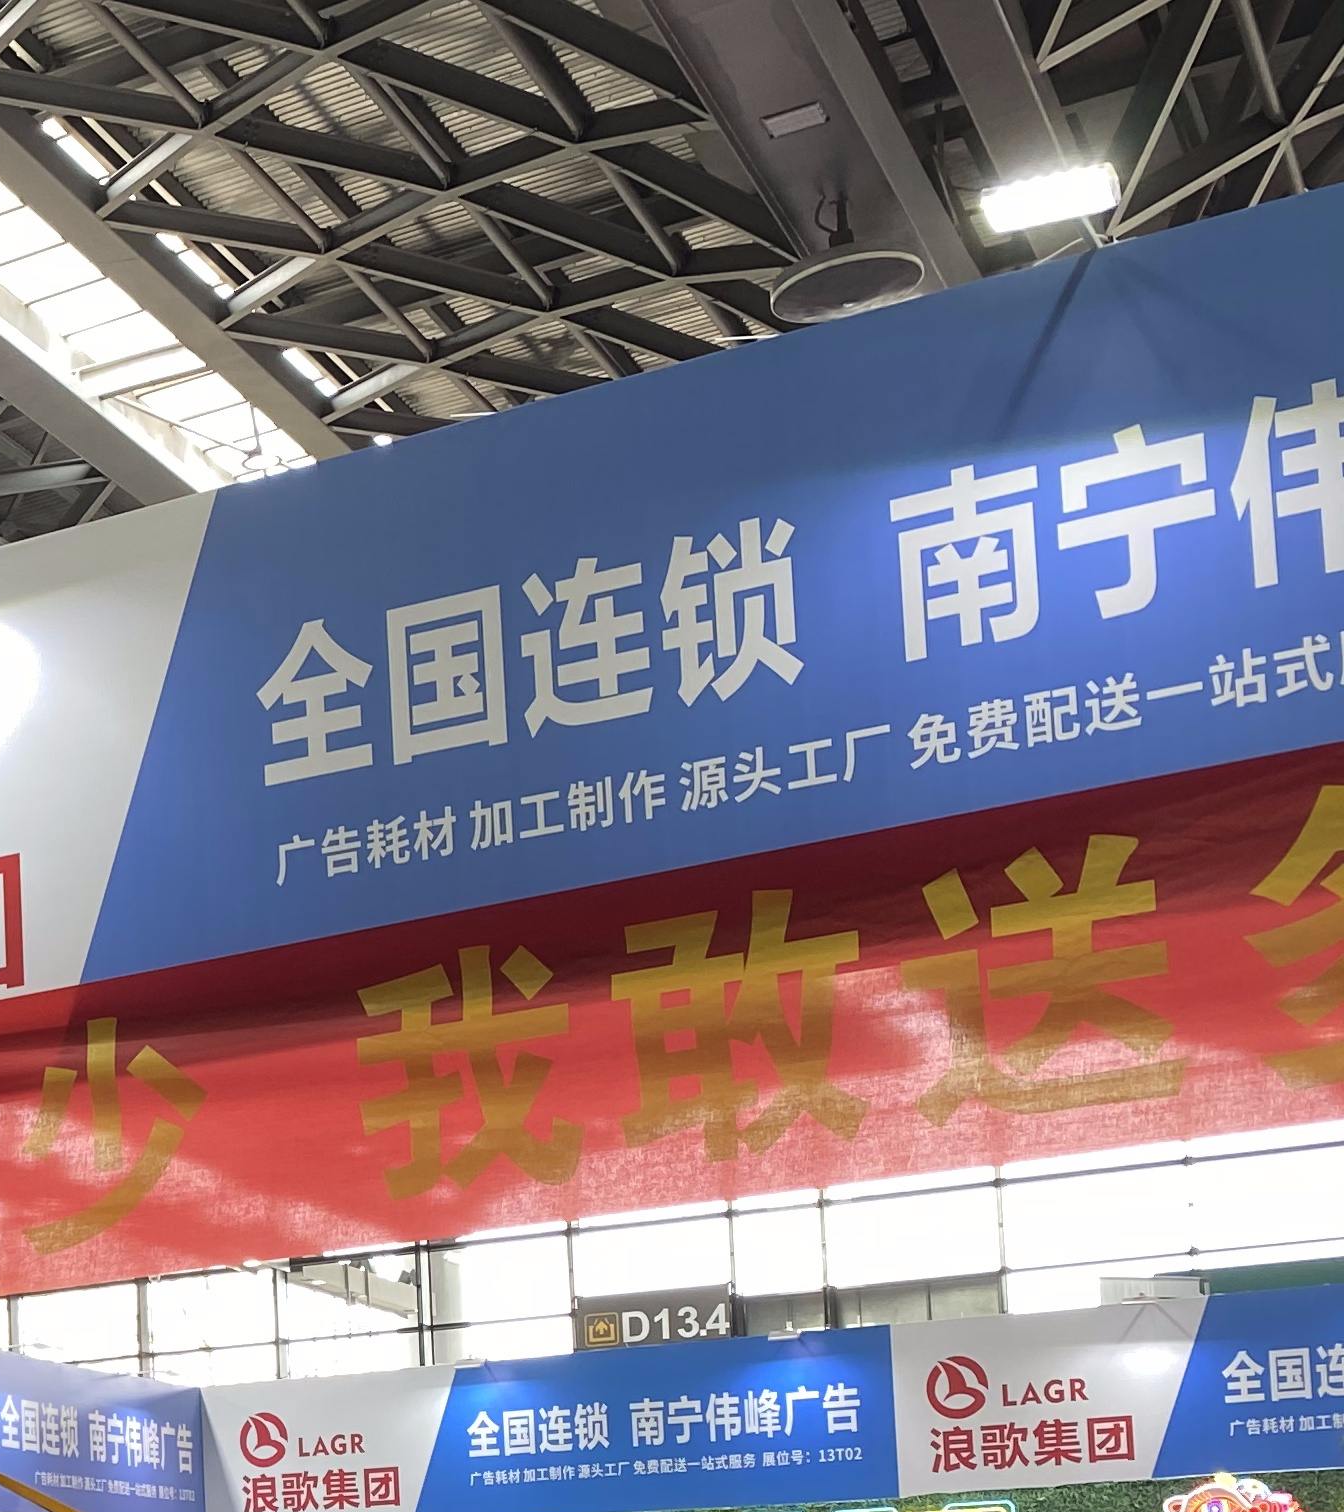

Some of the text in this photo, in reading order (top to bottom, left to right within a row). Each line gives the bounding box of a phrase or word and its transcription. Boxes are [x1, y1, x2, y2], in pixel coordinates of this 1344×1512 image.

[255, 517, 805, 787] 全国连锁
[275, 631, 1344, 886] 广告耗材 加工制作 源头工厂 免费配送一站式
[622, 1302, 731, 1344] D13.4
[1002, 1377, 1089, 1408] LAGR
[0, 1394, 194, 1475] 全国连锁 南宁伟峰广告
[298, 1433, 365, 1459] LAGR
[467, 1382, 862, 1459] 全国连锁 南宁伟峰广告
[930, 1414, 1136, 1474] 浪歌集团
[1229, 1414, 1295, 1437] 广告耗材
[469, 1468, 520, 1487] 广告耗材
[523, 1464, 576, 1483] 加工制作
[577, 1461, 631, 1479] 源头工厂
[633, 1453, 756, 1476] 免费配送一站式服务
